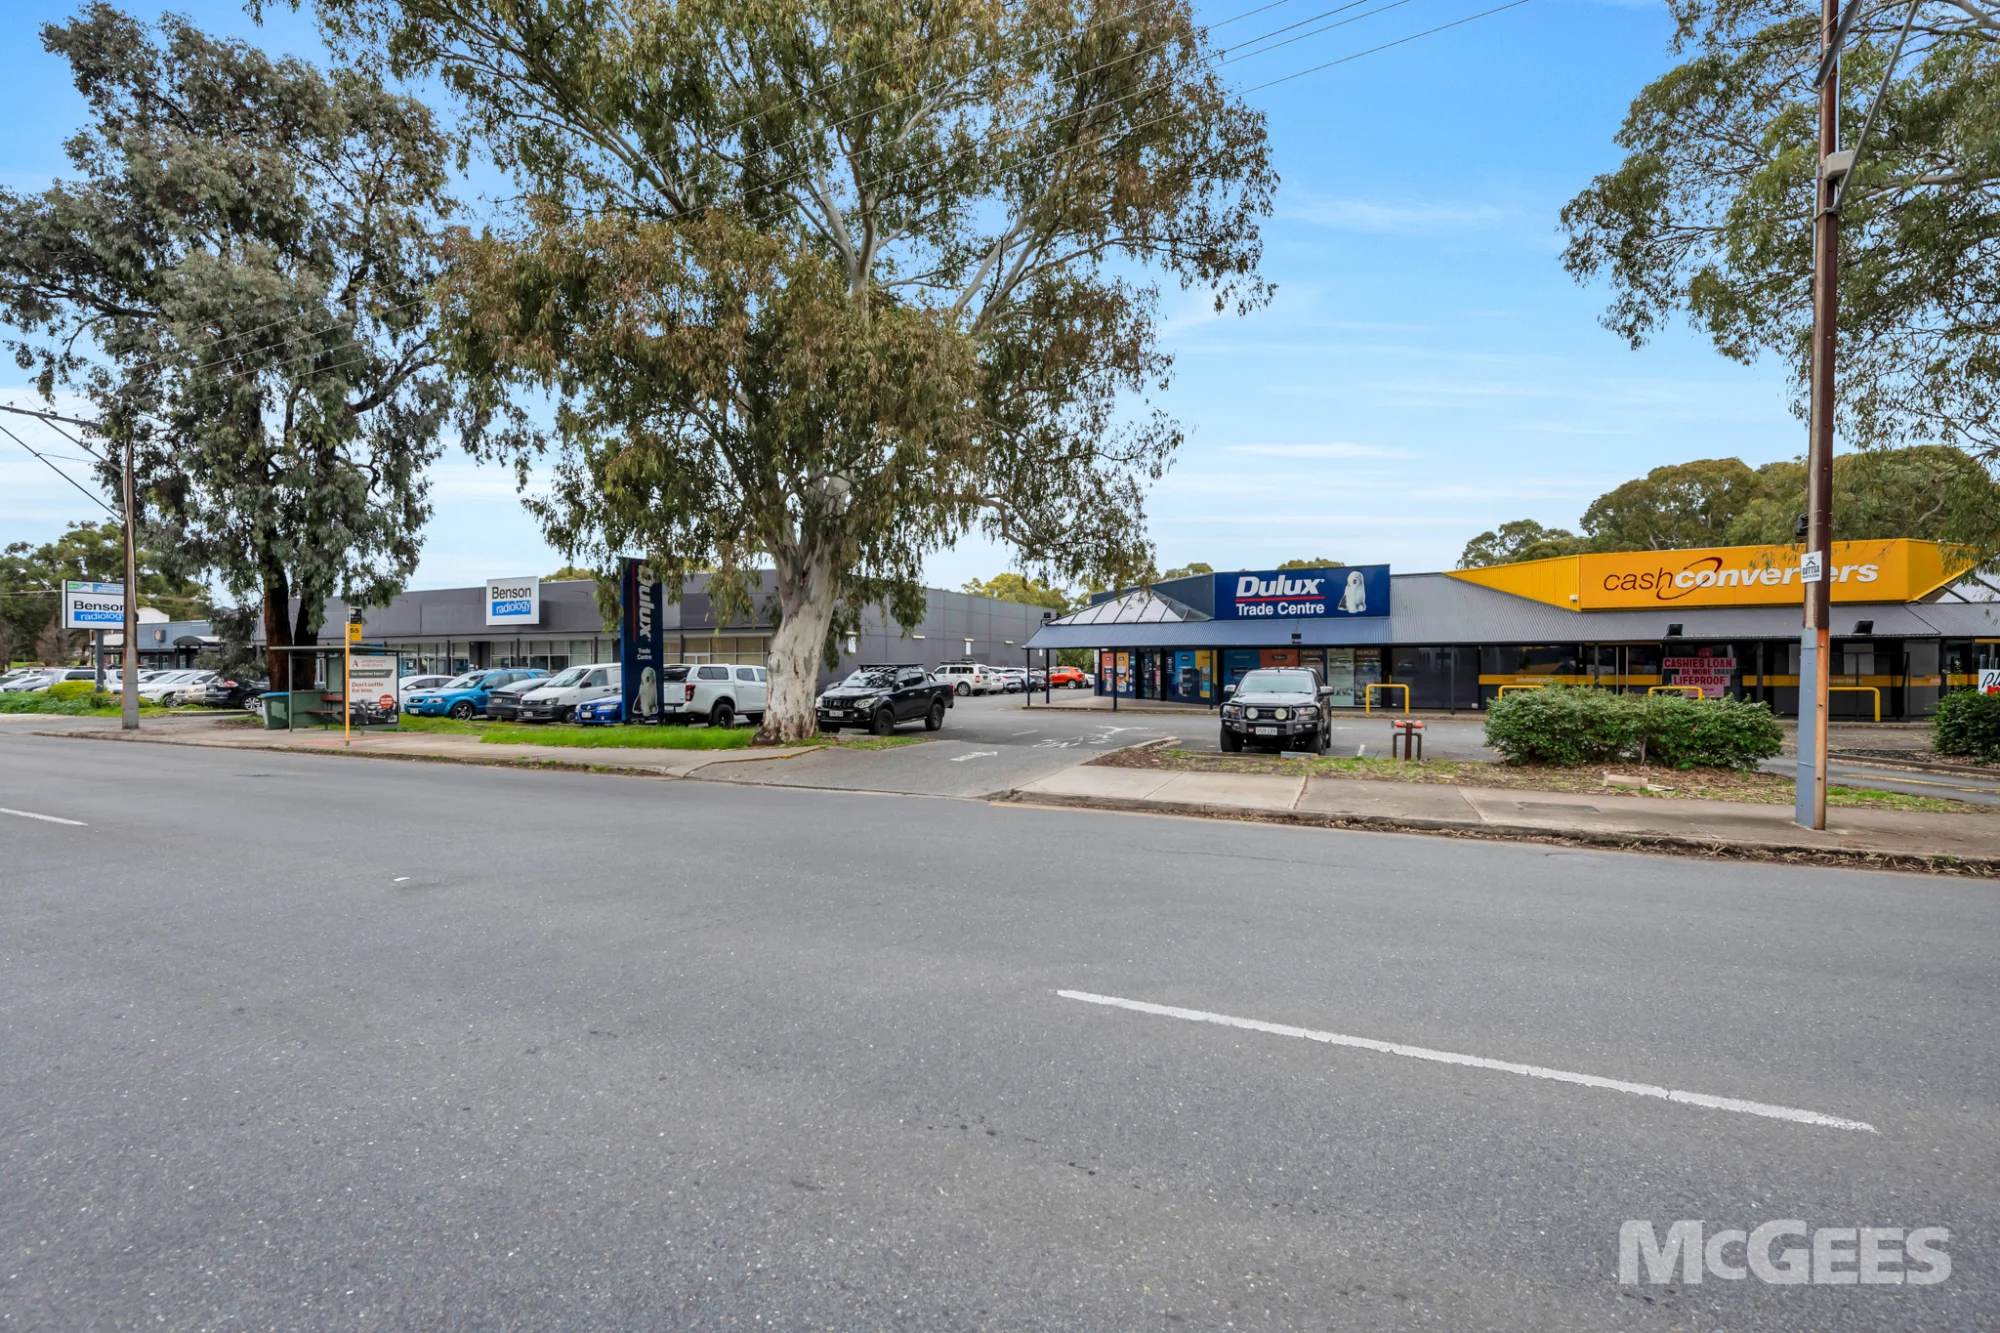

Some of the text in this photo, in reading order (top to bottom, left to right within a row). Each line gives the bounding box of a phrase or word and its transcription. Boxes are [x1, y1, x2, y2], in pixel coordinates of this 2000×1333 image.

[491, 586, 532, 599] Benson
[1236, 574, 1320, 597] Dulux
[496, 600, 531, 614] radiology
[1236, 602, 1325, 616] Trade Centre
[1664, 658, 1705, 668] CASHIES
